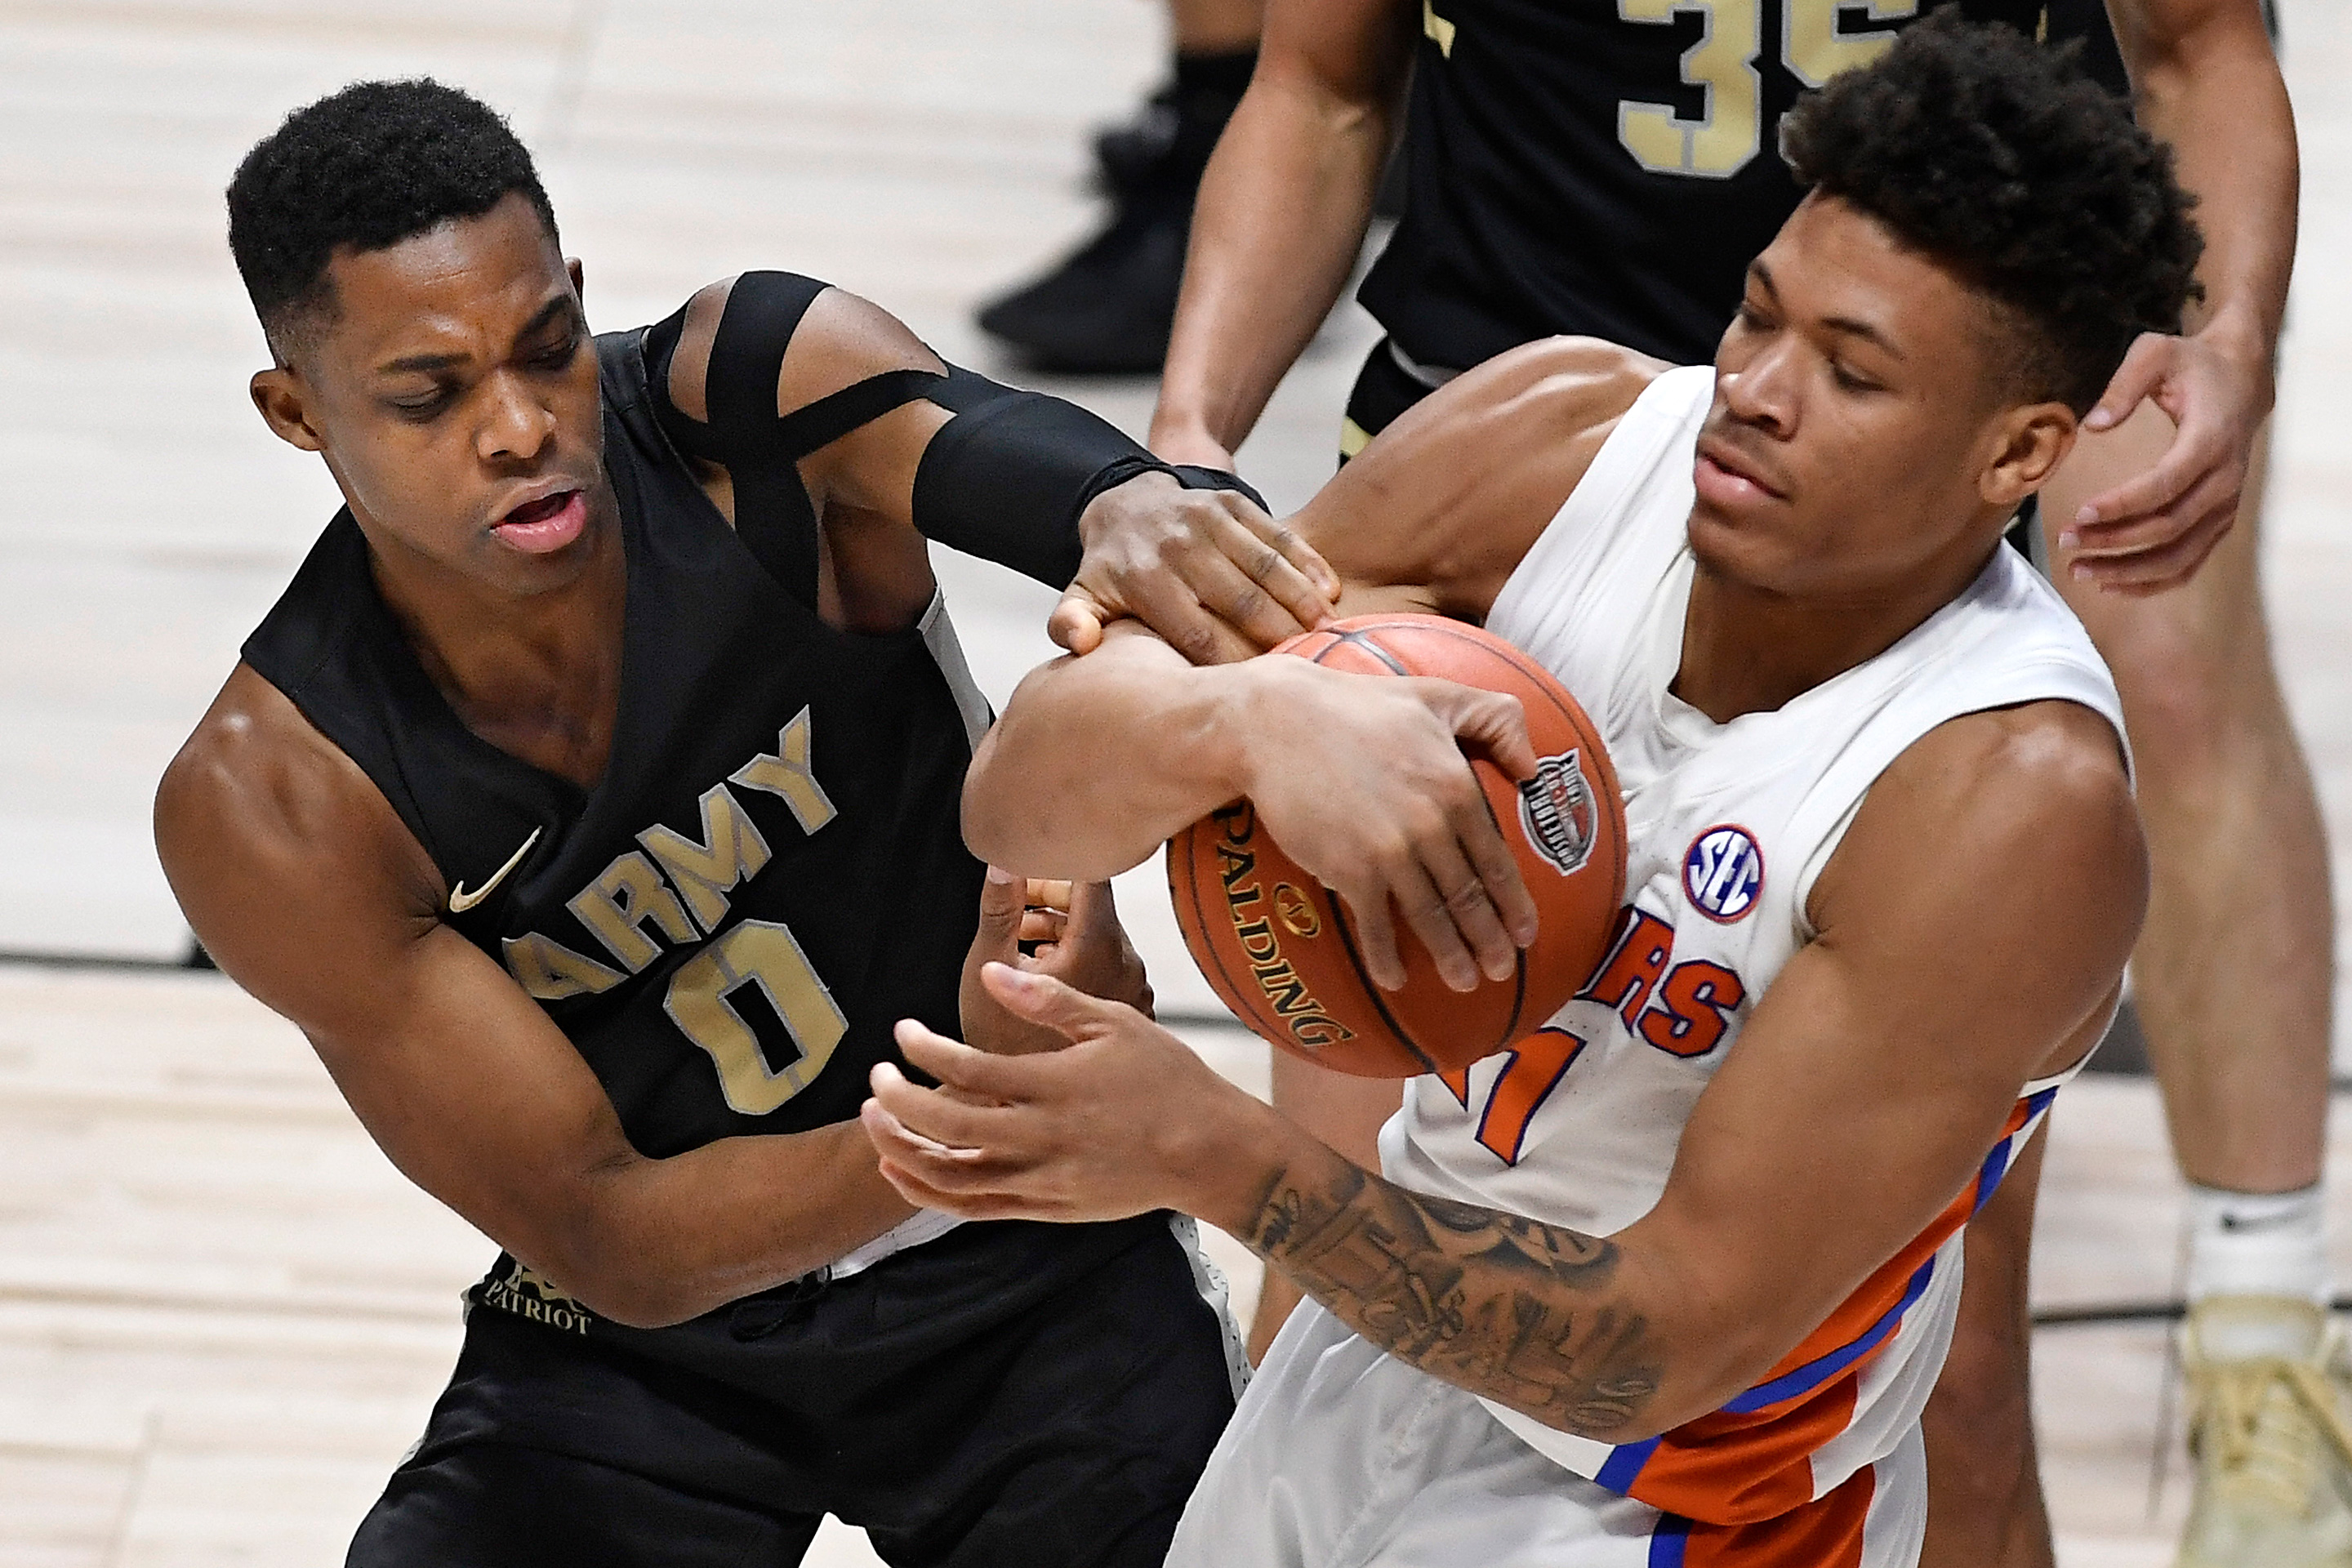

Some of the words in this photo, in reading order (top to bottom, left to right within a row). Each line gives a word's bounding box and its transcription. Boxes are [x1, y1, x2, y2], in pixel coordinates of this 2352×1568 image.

[501, 704, 838, 999] ARMY
[1688, 829, 1761, 915] SEC
[662, 918, 849, 1115] 0
[1573, 902, 1746, 1058] RS
[484, 1278, 592, 1334] PATRIOT
